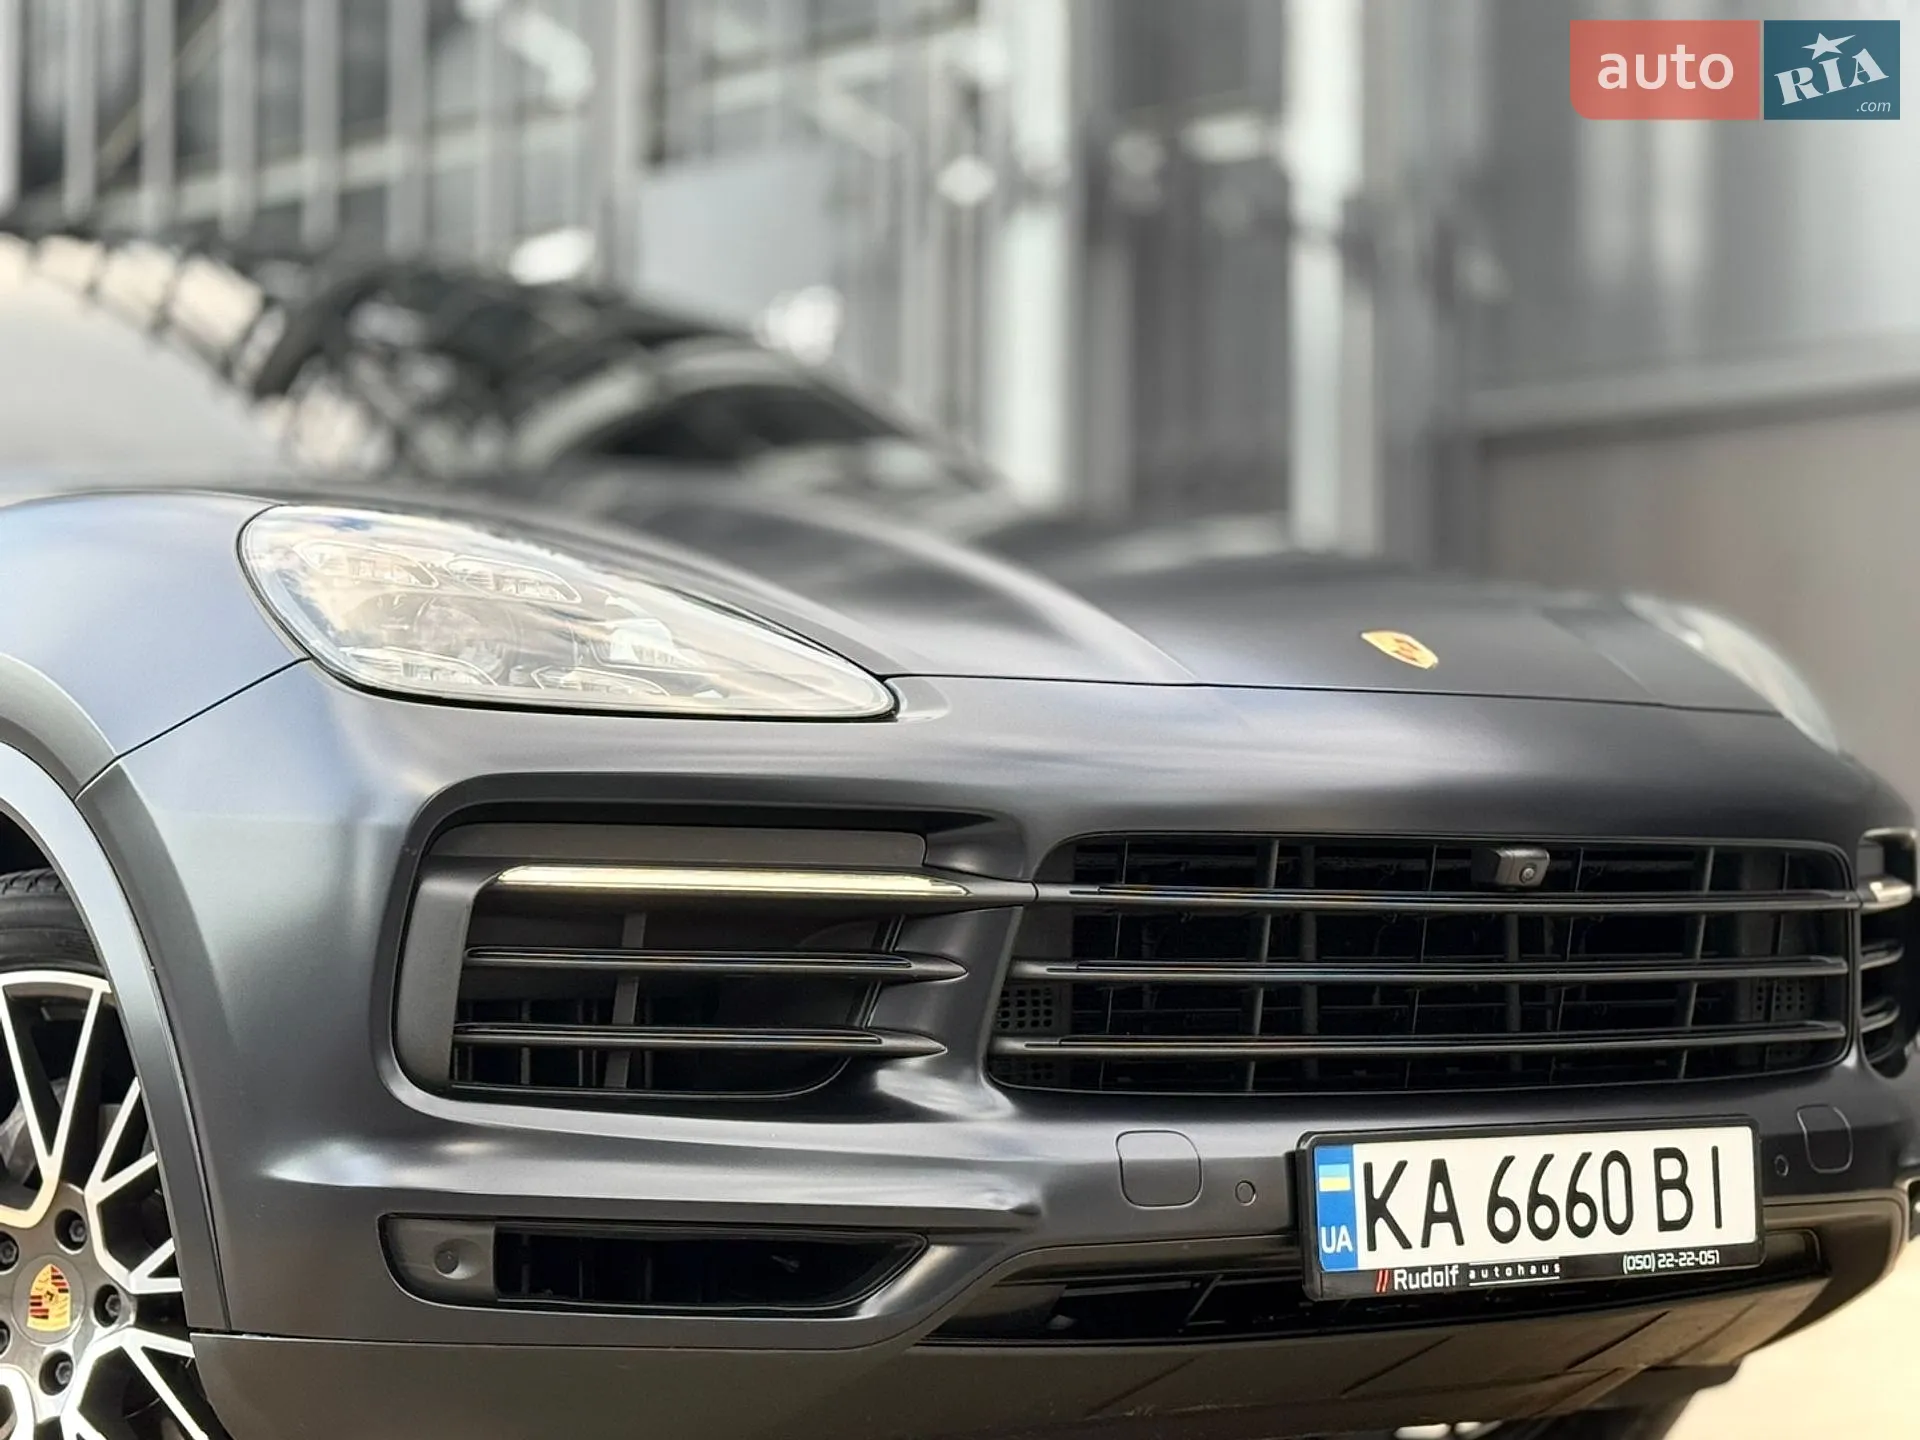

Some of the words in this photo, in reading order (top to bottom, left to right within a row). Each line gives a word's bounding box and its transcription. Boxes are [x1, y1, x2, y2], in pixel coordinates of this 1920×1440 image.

[1363, 1159, 1465, 1252] KA
[1486, 1149, 1634, 1244] 6660
[1653, 1145, 1723, 1232] BI
[1321, 1225, 1354, 1254] UA
[1622, 1252, 1656, 1274] (050)
[1657, 1249, 1721, 1269] 22-22-051
[1394, 1264, 1459, 1291] Rudolf
[1469, 1262, 1561, 1280] autohaus
